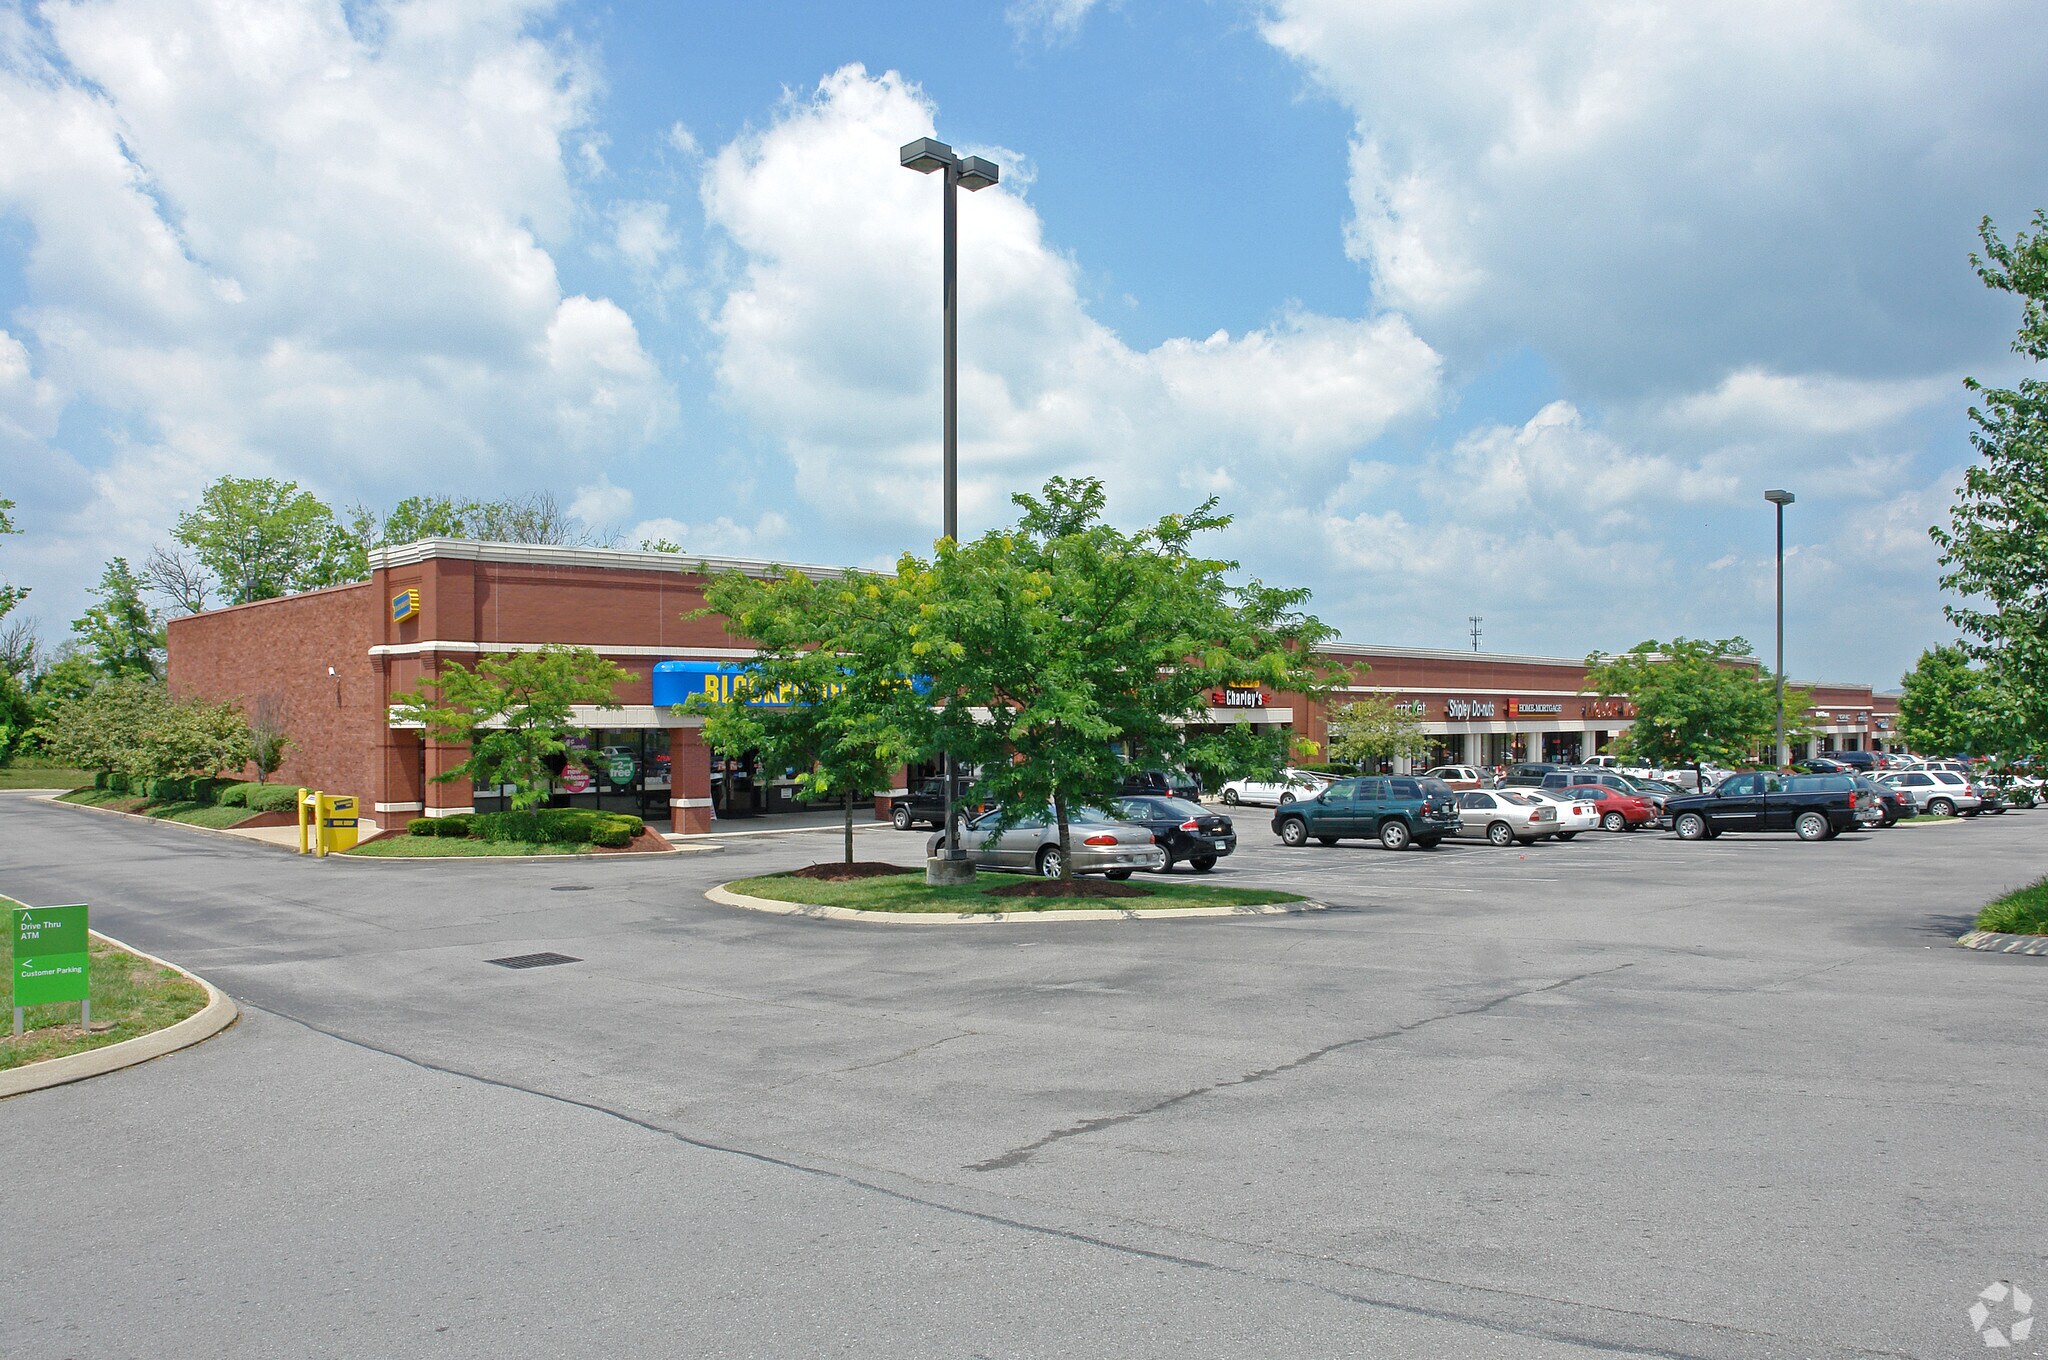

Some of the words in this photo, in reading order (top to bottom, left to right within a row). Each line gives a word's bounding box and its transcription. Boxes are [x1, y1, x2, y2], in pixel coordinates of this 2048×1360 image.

[1226, 690, 1263, 708] Charley's
[1395, 700, 1426, 716] cricket
[1449, 699, 1471, 720] Shipley
[1472, 700, 1495, 717] Do-nuts
[21, 932, 40, 940] ATM
[21, 969, 55, 977] Customer
